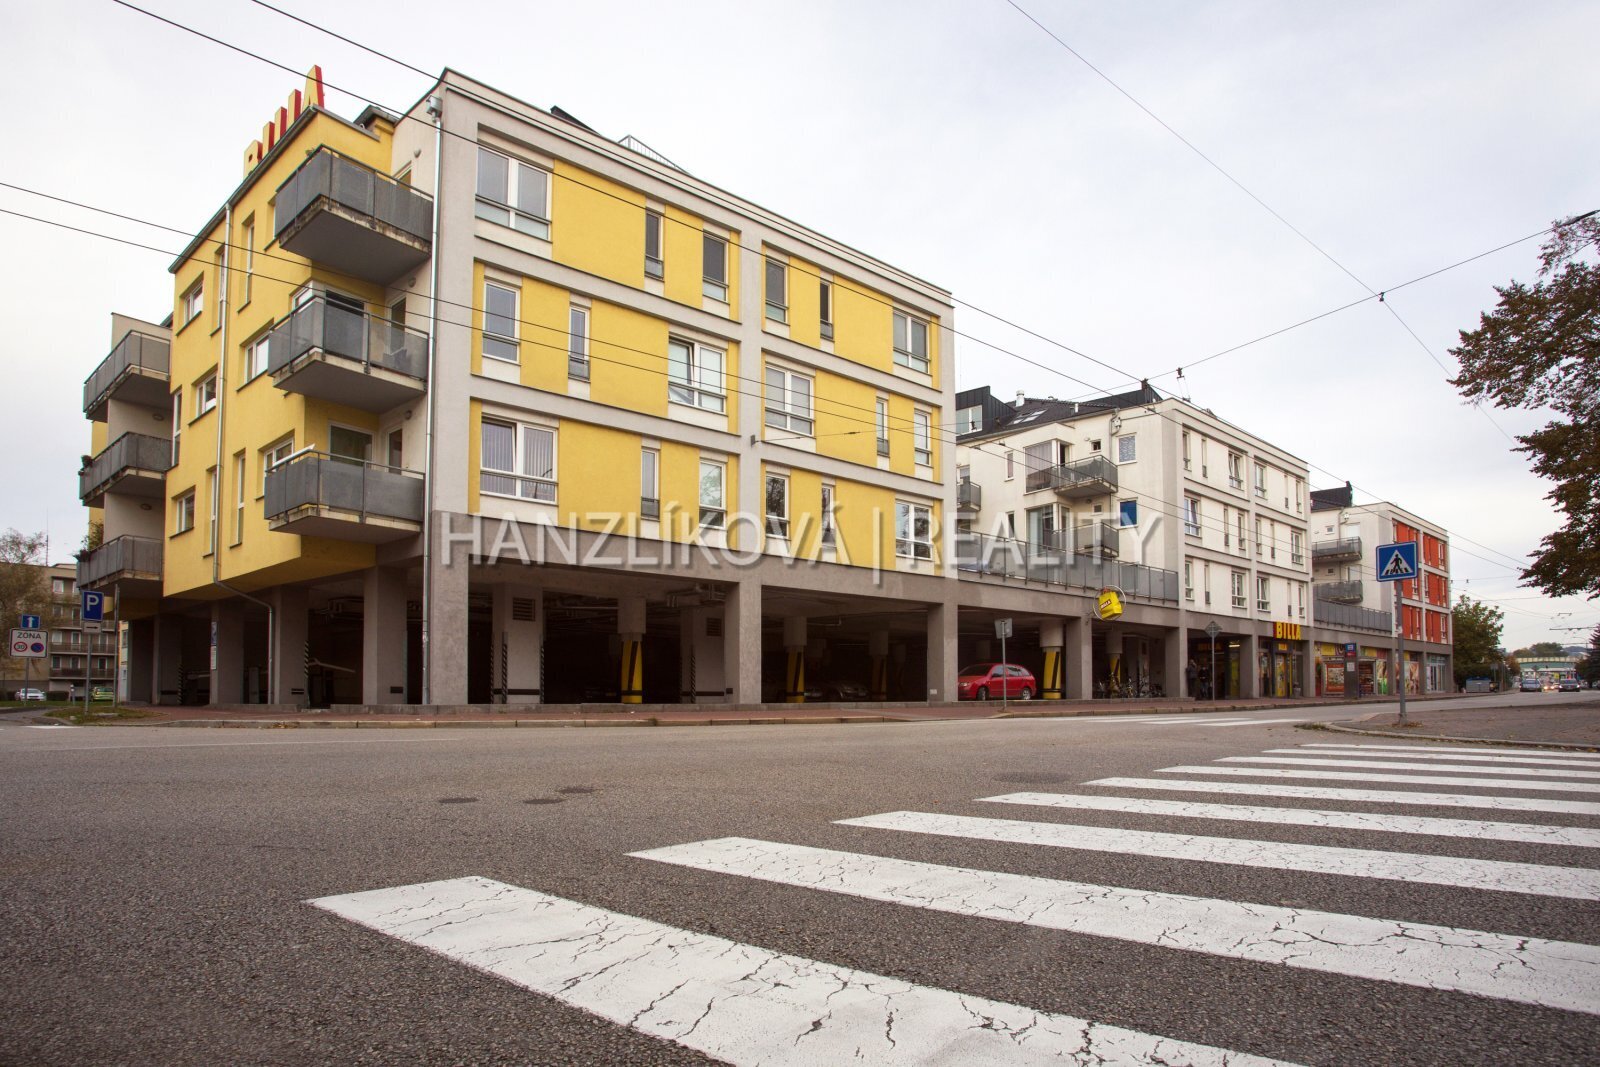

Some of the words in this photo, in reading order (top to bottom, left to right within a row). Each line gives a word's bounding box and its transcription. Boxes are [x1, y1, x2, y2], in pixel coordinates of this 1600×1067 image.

[87, 594, 99, 611] P
[17, 631, 41, 640] ZONA
[1275, 621, 1301, 641] BILLA
